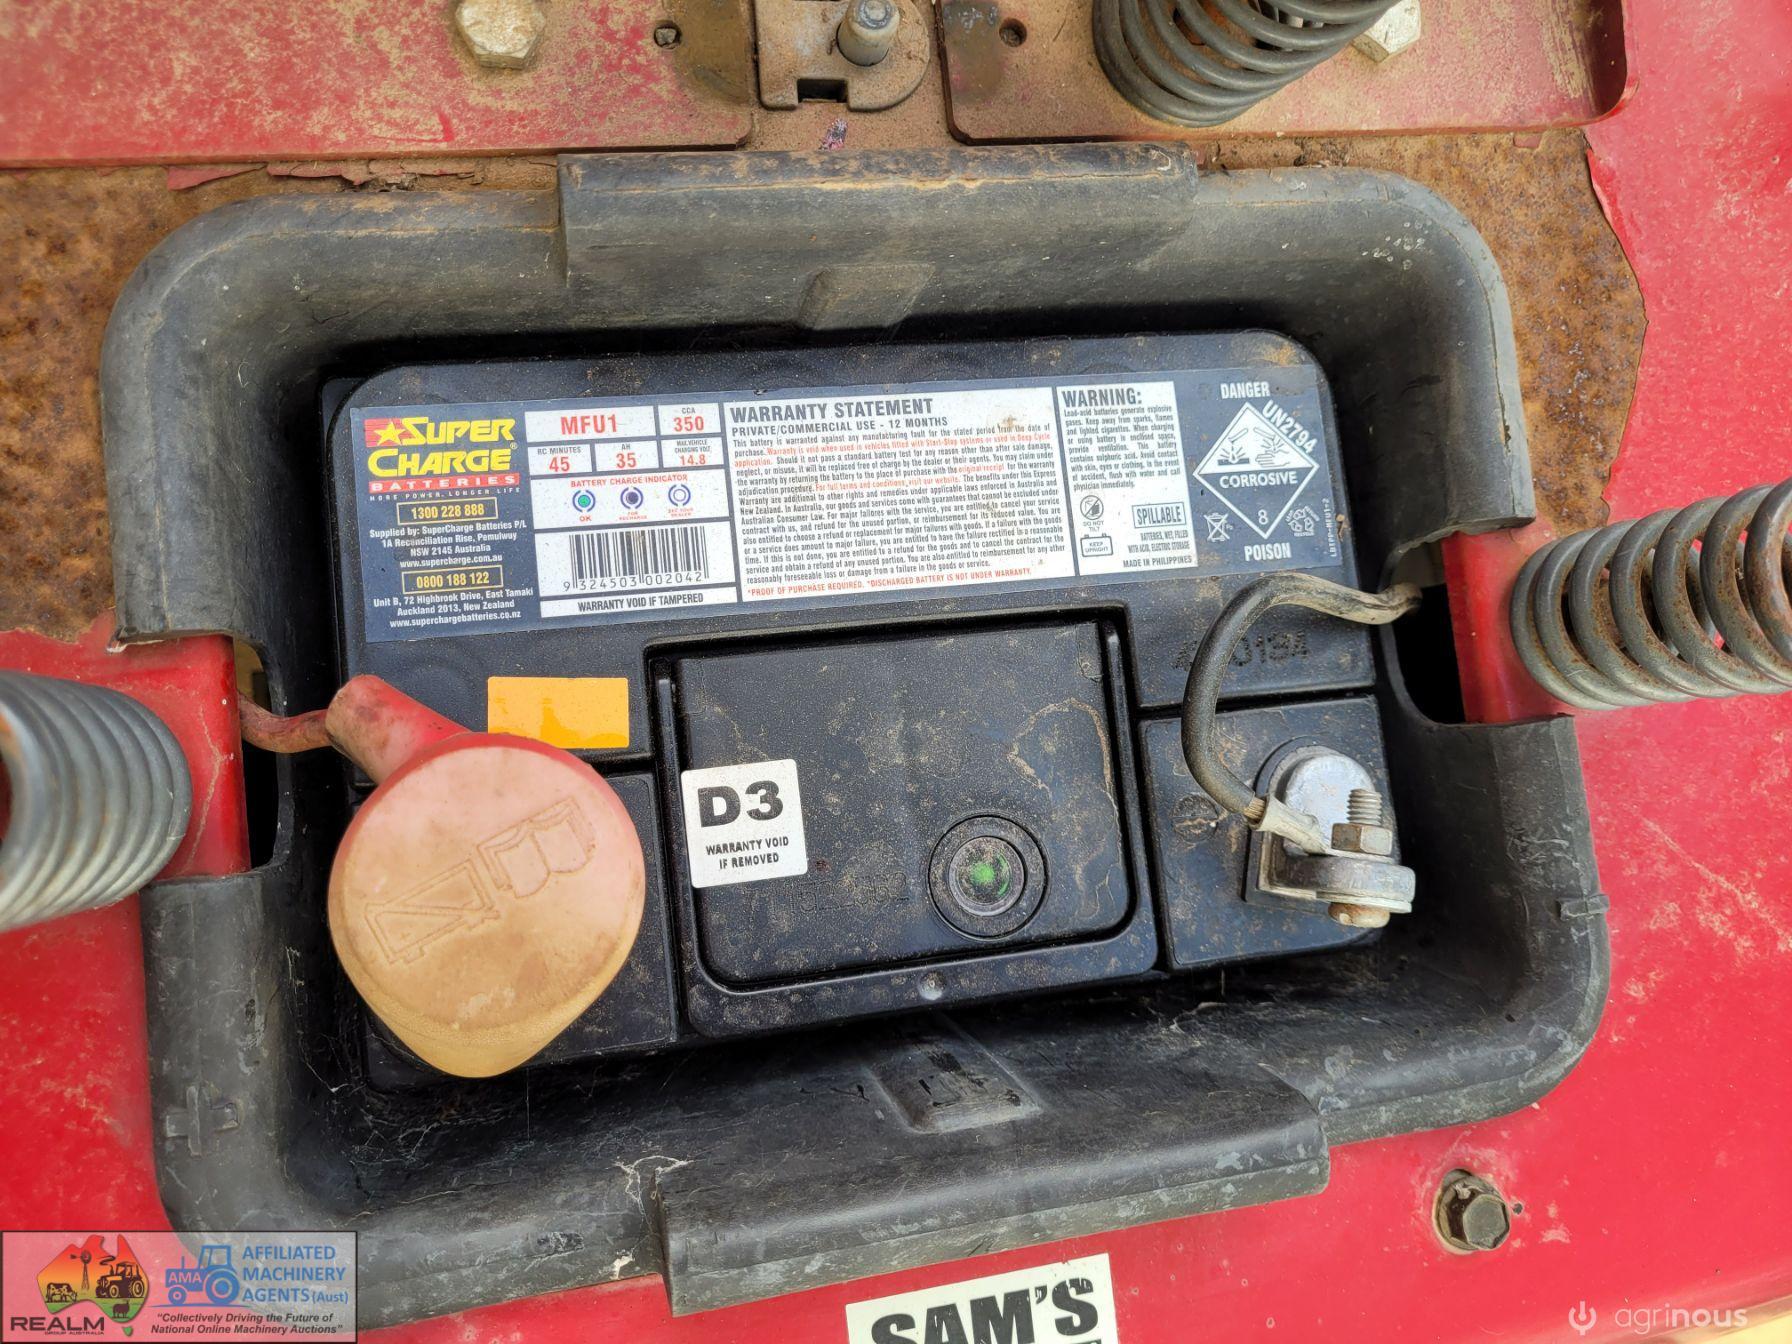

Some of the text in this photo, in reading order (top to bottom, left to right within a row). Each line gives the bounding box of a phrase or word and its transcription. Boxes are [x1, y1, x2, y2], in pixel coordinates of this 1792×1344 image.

[1061, 387, 1141, 407] WARNING:
[1220, 381, 1270, 398] DANGER
[730, 398, 933, 423] WARRANTY STATEMENT
[401, 416, 516, 446] SUPER
[560, 414, 617, 434] MFU1
[673, 416, 704, 431] 350
[732, 419, 852, 437] PRIVATE/COMMERCIAL
[856, 420, 875, 429] USE
[888, 419, 900, 428] 12
[905, 416, 947, 427] MONTHS
[1262, 400, 1318, 453] UN2794
[750, 439, 773, 447] battery
[785, 436, 817, 444] warranted
[821, 435, 844, 443] against
[862, 432, 907, 441] manufacturing
[976, 427, 995, 435] period
[549, 446, 580, 454] MINUTES
[548, 456, 570, 472] 45
[615, 452, 636, 468] 35
[679, 454, 705, 465] 14.8
[370, 475, 516, 492] BATTERIES
[570, 474, 687, 487] BATTERY CHARGE INDICATOR
[1219, 470, 1298, 489] CORROSIVE
[411, 503, 484, 519] 1300 228 888
[1136, 506, 1181, 524] SPILLABLE
[1257, 509, 1268, 524] 8
[369, 520, 526, 539] Supplied by: SuperCharge Batteries P/L
[382, 539, 392, 547] 1A
[395, 535, 452, 546] Reconciliation
[455, 534, 475, 543] Rise,
[410, 543, 491, 556] NSW 2145 Australia
[1243, 542, 1291, 561] POISON
[399, 553, 503, 568] www.supercharge.com.au
[1123, 559, 1141, 567] MADE
[1152, 555, 1191, 565] PHILIPPINES
[416, 571, 489, 588] 0800 188 122
[563, 572, 701, 591] 9 324503 002042
[746, 570, 836, 585] reasonably foreseeable loss
[777, 586, 785, 594] OF
[788, 583, 825, 593] PURCHASE
[915, 574, 944, 583] BATTERY
[946, 573, 953, 581] IS
[955, 572, 968, 580] NOT
[970, 571, 992, 579] UNDER
[373, 598, 390, 607] Unit
[403, 596, 414, 604] 72
[417, 593, 458, 604] Highbrook
[460, 591, 483, 601] Drive,
[485, 589, 502, 598] East
[505, 587, 533, 597] Tamaki
[577, 593, 703, 611] WARRANTY VOID IF TAMPERED
[397, 599, 514, 615] Auckland 2013, New Zealand
[389, 609, 522, 628] www.superchargebatteries.co.nz
[698, 780, 783, 827] D3
[706, 837, 789, 855] WARRANTY VOID
[720, 853, 779, 869] IF REMOVED
